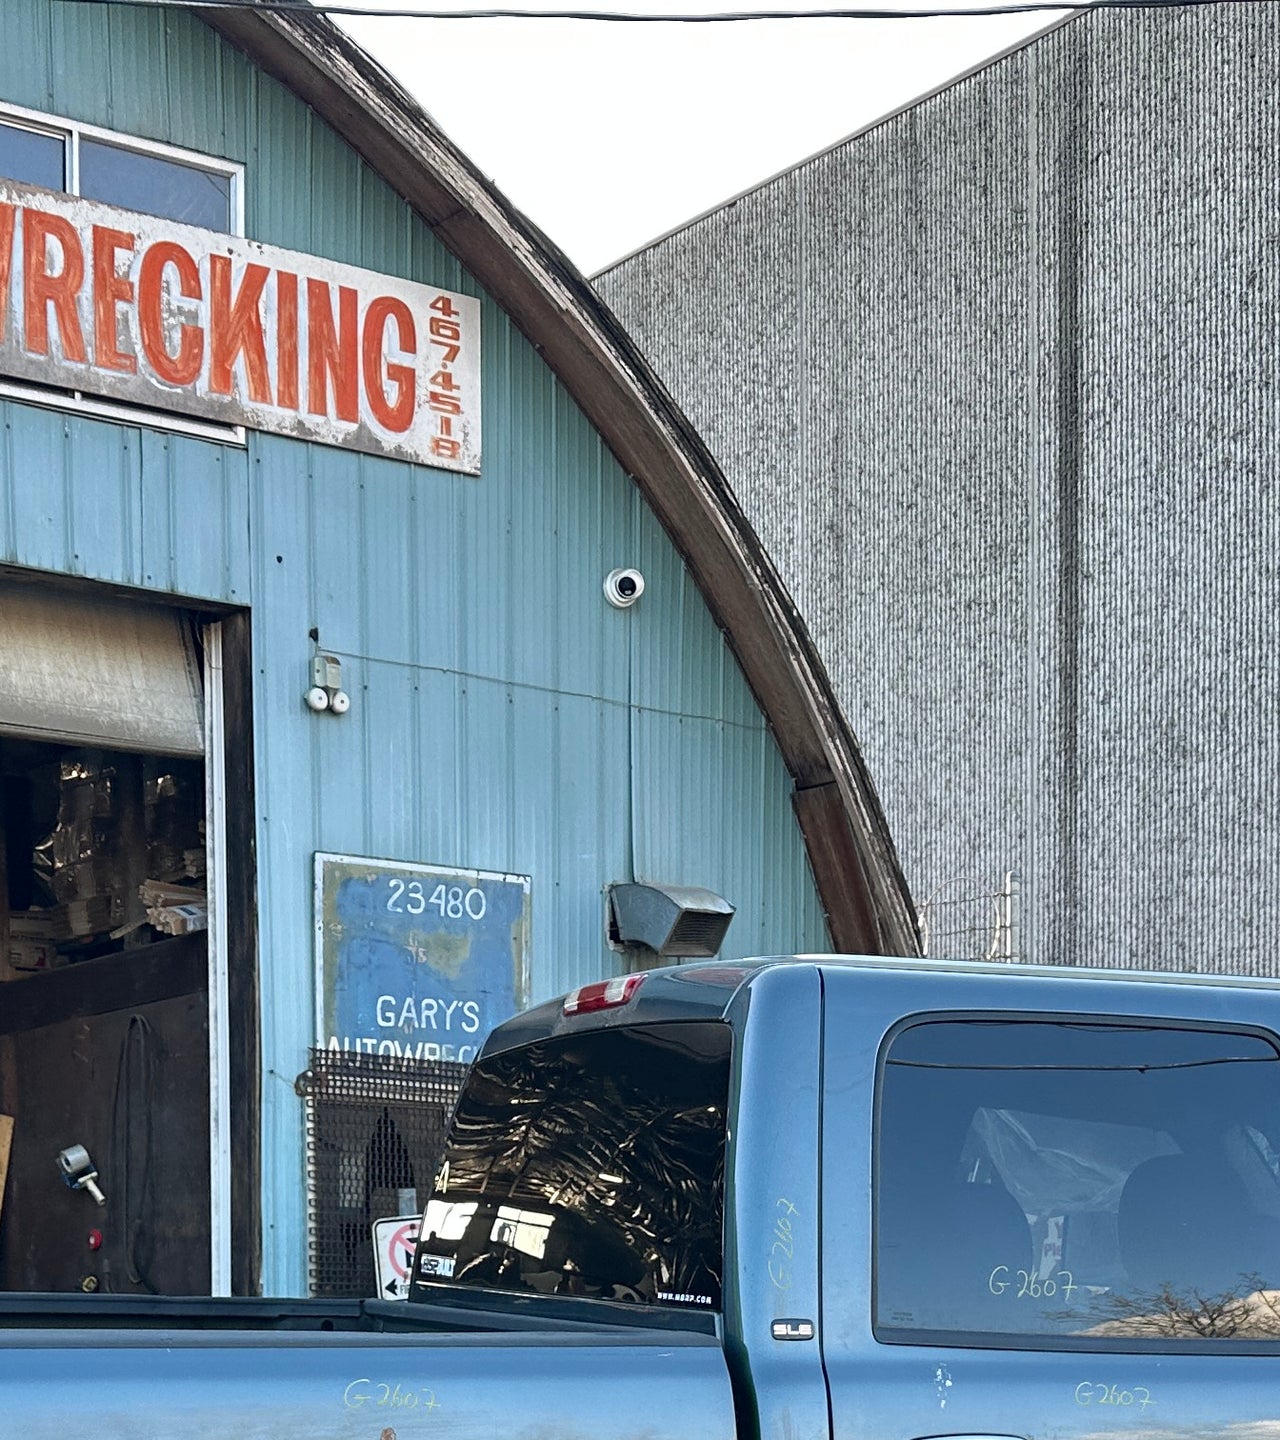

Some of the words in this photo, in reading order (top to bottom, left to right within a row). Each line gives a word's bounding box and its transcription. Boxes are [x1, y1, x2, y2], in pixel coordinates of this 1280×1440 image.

[386, 878, 487, 920] 23480
[376, 995, 480, 1033] GARY'S
[988, 1264, 1078, 1304] G2607
[773, 1324, 812, 1336] SLE
[1075, 1380, 1157, 1411] G2607
